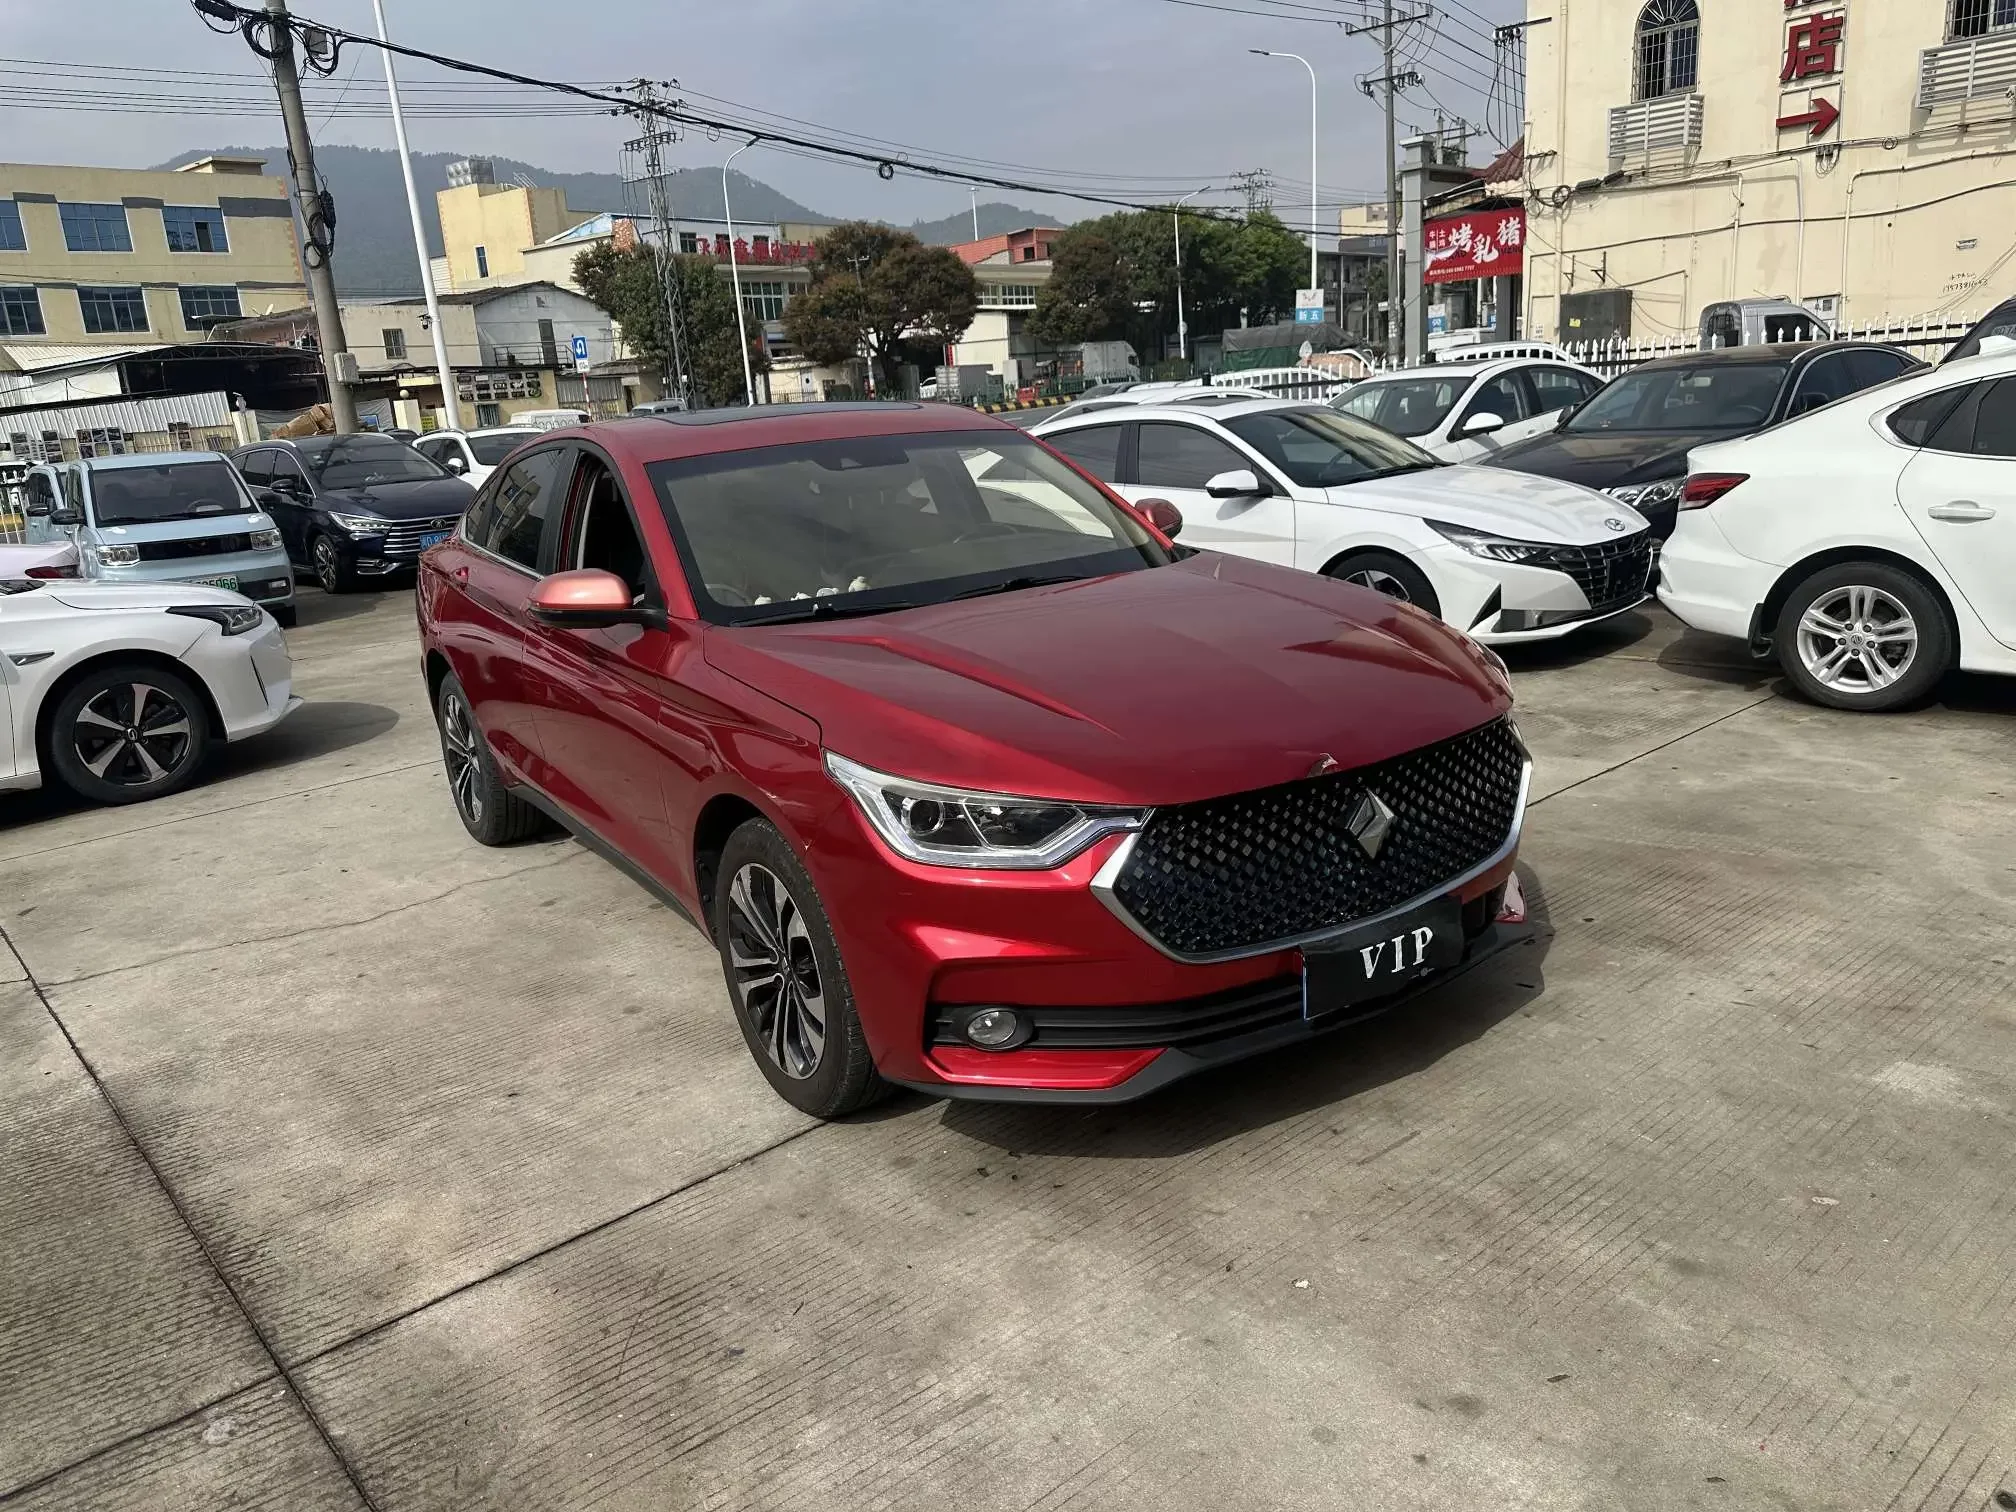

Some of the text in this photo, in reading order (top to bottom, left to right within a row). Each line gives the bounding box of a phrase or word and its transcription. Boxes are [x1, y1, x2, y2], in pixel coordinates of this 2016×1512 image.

[1779, 0, 1844, 83] 店
[1448, 216, 1521, 264] 烤乳猪
[1360, 926, 1434, 979] VIP
